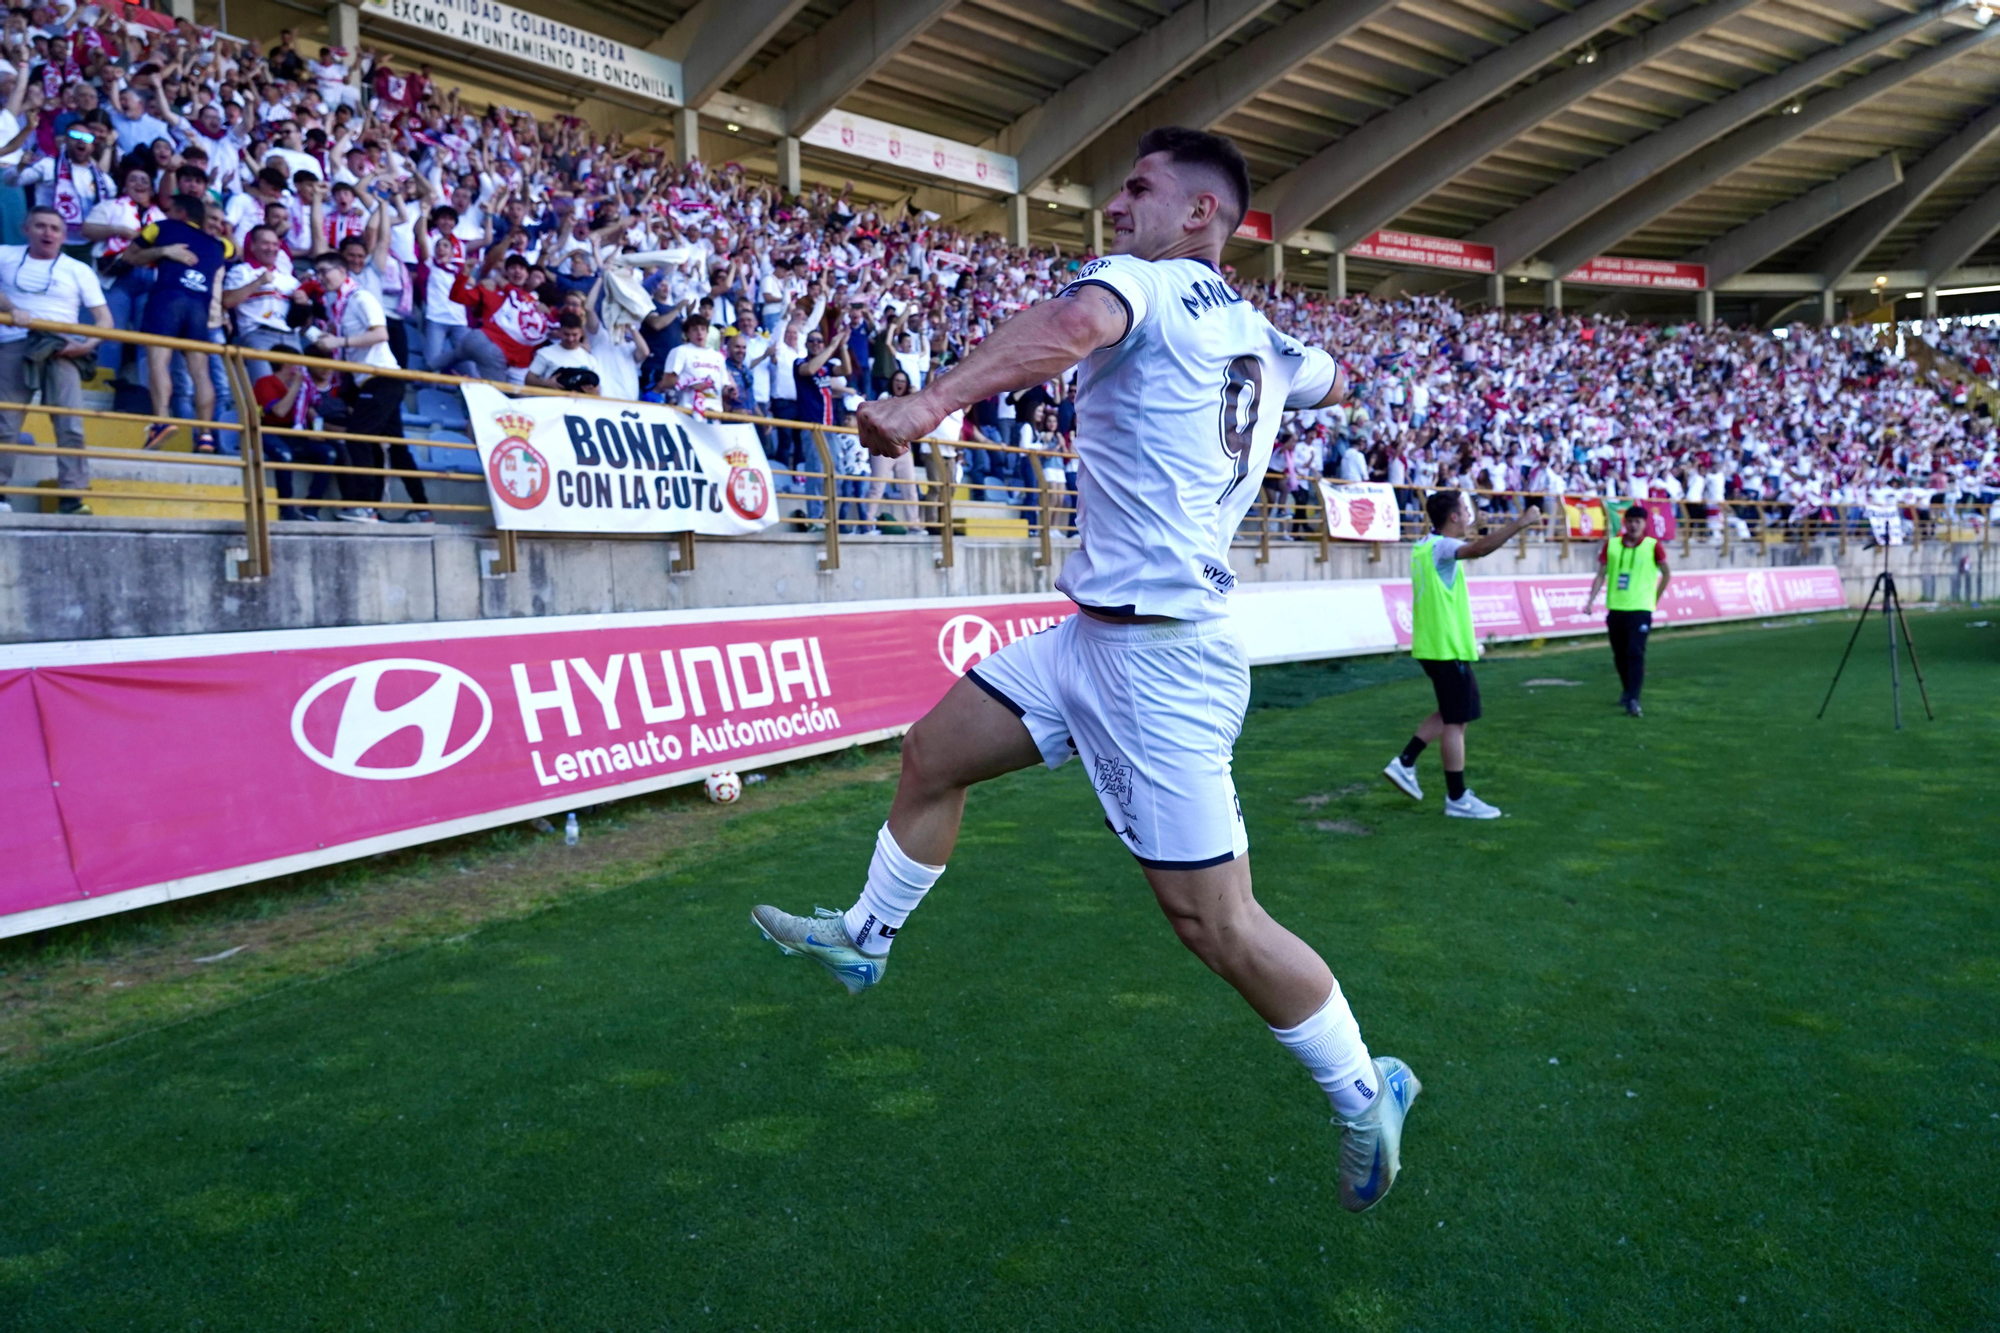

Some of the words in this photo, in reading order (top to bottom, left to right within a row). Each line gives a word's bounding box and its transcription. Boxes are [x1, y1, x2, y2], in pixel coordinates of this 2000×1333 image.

[393, 0, 454, 33] EXCMO.
[462, 20, 574, 69] AYUNTAMIENTO
[582, 57, 597, 76] DE
[603, 64, 675, 99] ONZONILLA
[436, 0, 501, 23] TIDAD
[511, 12, 625, 63] COLABORADORA
[557, 470, 613, 509] CON
[619, 474, 651, 510] LA
[510, 637, 831, 743] HYUNDAI
[531, 731, 683, 787] Lemauto
[690, 701, 841, 757] Automoción
